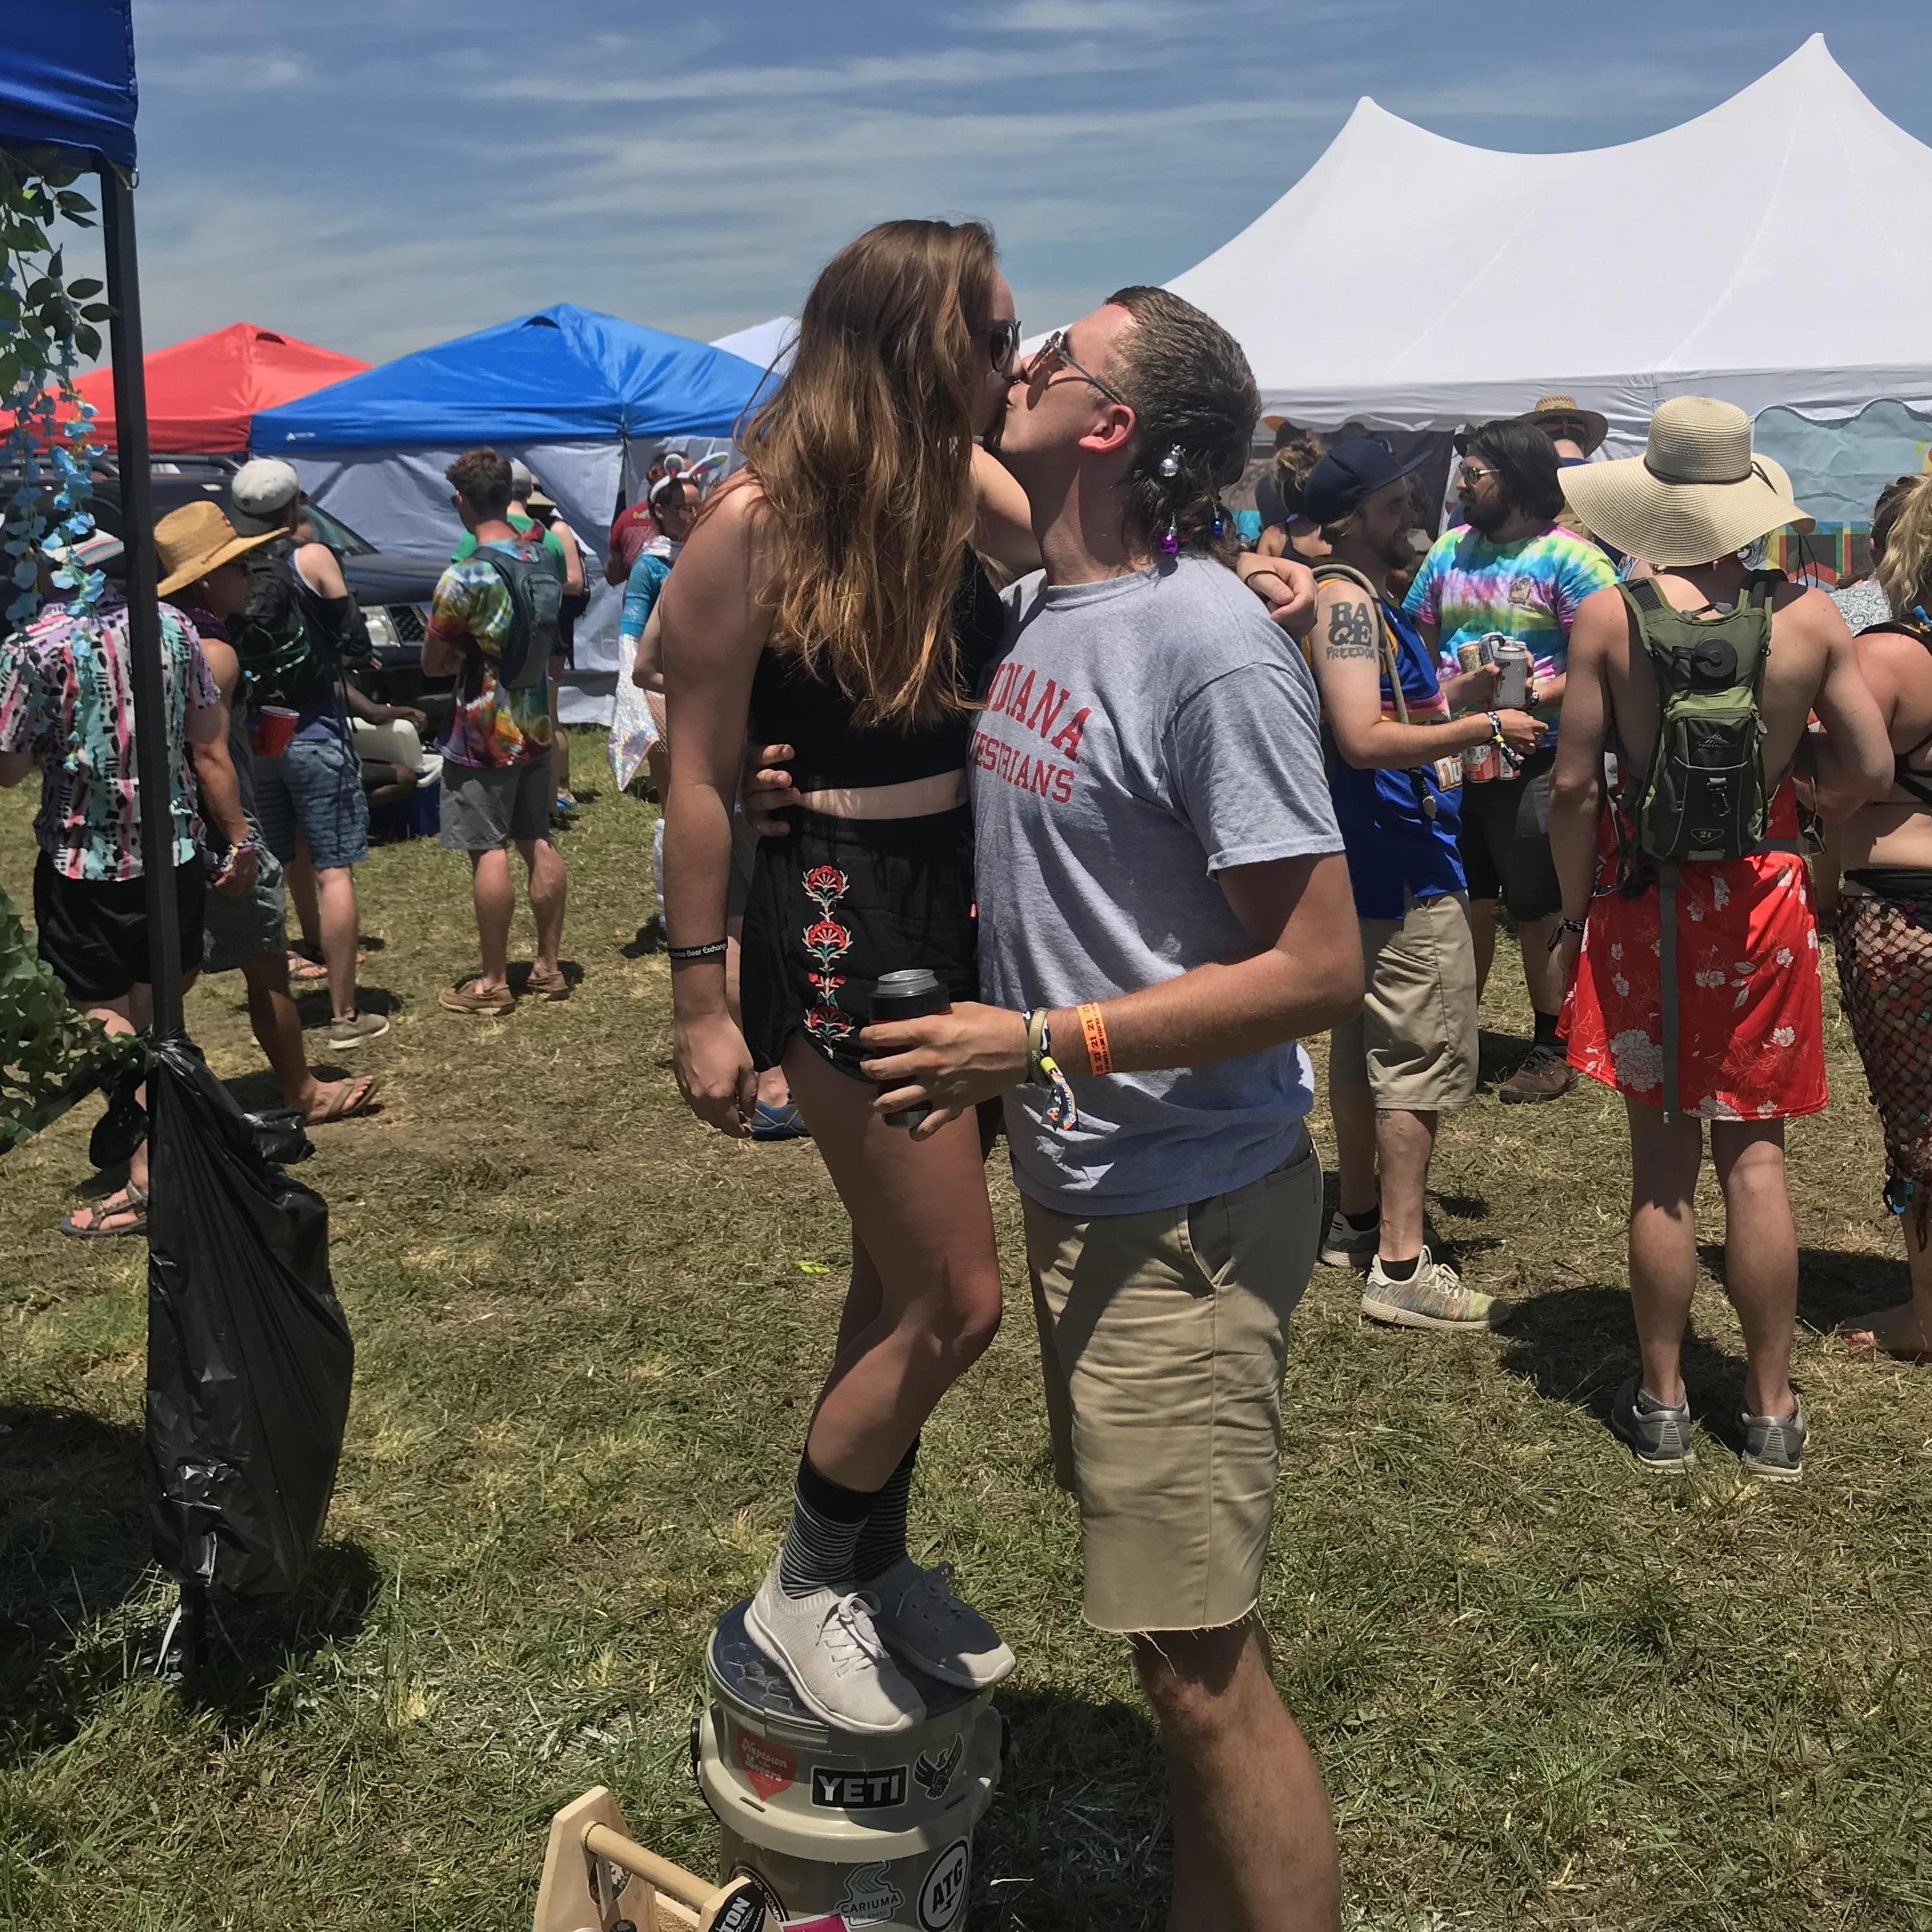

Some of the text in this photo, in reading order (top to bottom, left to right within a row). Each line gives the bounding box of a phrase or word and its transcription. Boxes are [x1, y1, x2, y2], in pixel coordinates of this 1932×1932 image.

[687, 949, 702, 957] Beer
[1087, 1018, 1094, 1031] 21
[1090, 1035, 1098, 1048] 21
[816, 1775, 900, 1803] YETI
[764, 1892, 782, 1922] COMP
[842, 1894, 898, 1914] CARIUMA
